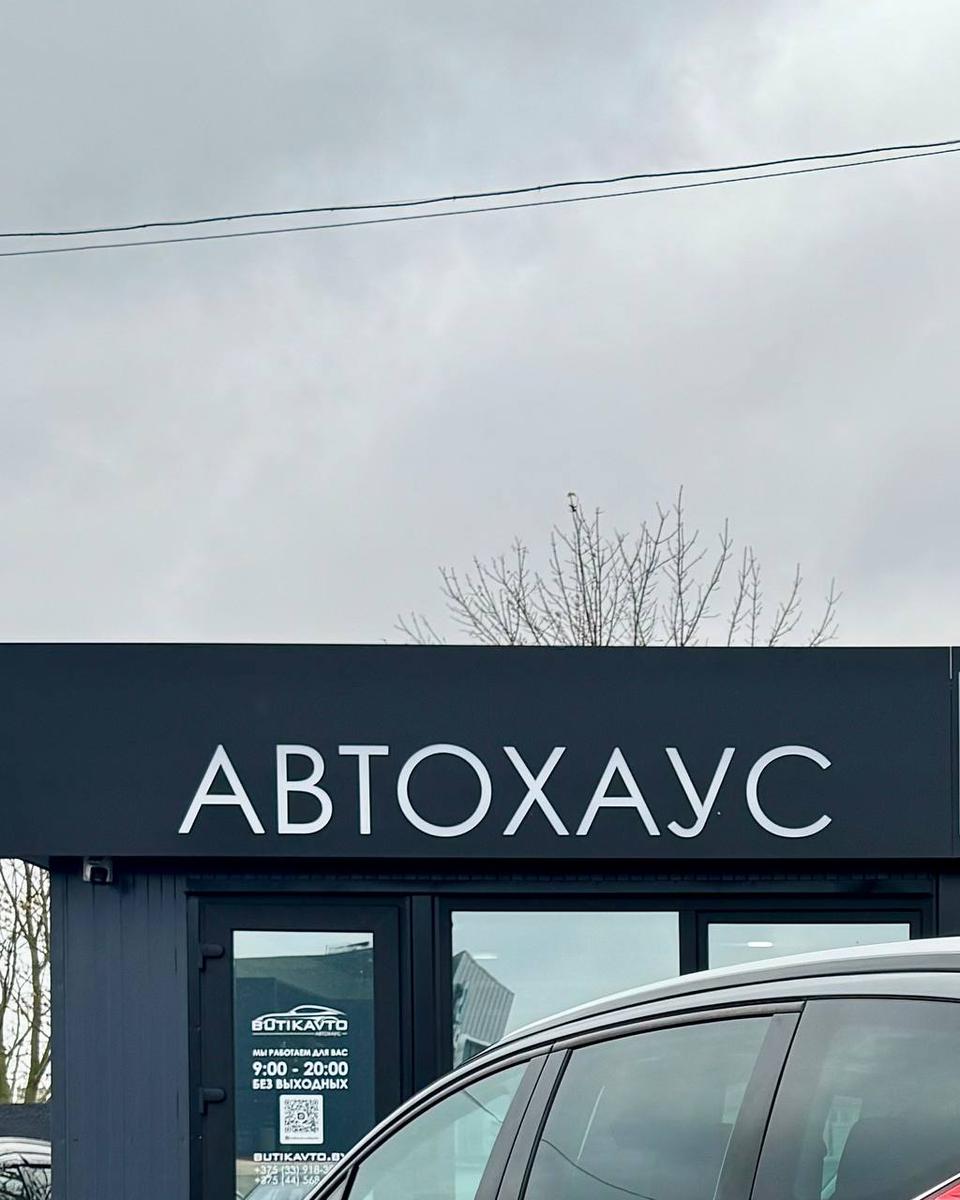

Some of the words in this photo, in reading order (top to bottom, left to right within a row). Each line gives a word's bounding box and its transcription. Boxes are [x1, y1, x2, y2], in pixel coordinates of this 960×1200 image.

[178, 743, 833, 838] АВТОХАУС
[251, 1019, 348, 1031] BUTIKAVTO
[252, 1048, 267, 1057] МЫ
[268, 1048, 311, 1057] РАБОТАЕМ
[312, 1048, 329, 1058] ДЛЯ
[331, 1048, 349, 1057] ВАС
[252, 1061, 288, 1076] 9:00
[303, 1061, 349, 1076] 20:00
[252, 1078, 273, 1090] БЕЗ
[275, 1078, 348, 1091] ВЫХОДНЫХ
[254, 1164, 279, 1175] +375
[281, 1164, 300, 1176] (33)
